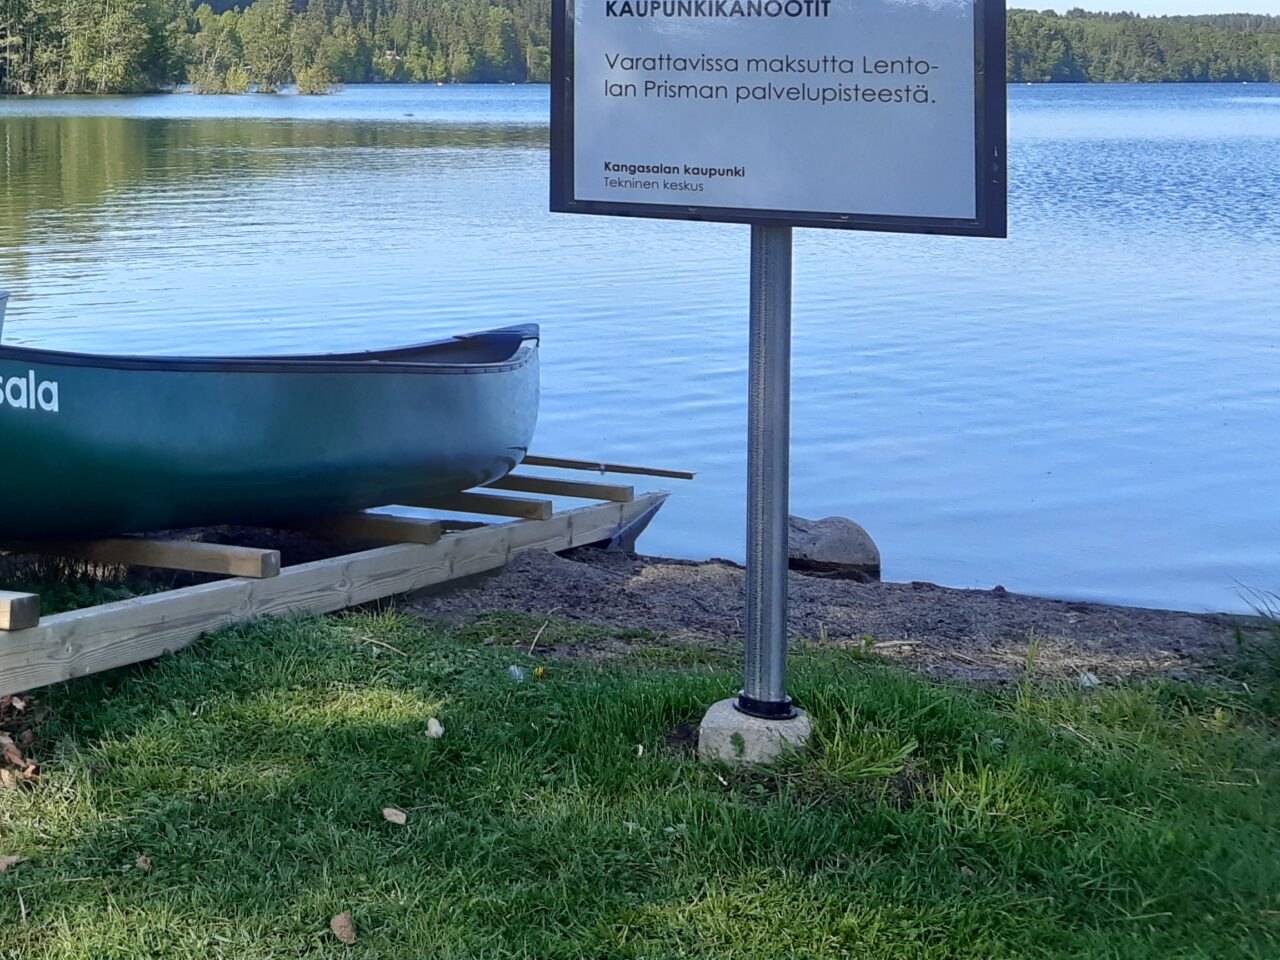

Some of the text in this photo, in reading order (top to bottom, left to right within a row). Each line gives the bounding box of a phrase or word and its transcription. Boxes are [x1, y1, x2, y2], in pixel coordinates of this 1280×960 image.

[604, 52, 939, 75] Varattavissa maksutta Lento-
[604, 79, 936, 105] lan Prisman palvelupisteestä.
[604, 161, 745, 179] Kangasalan kaupunki
[604, 176, 704, 192] Tekninen keskus
